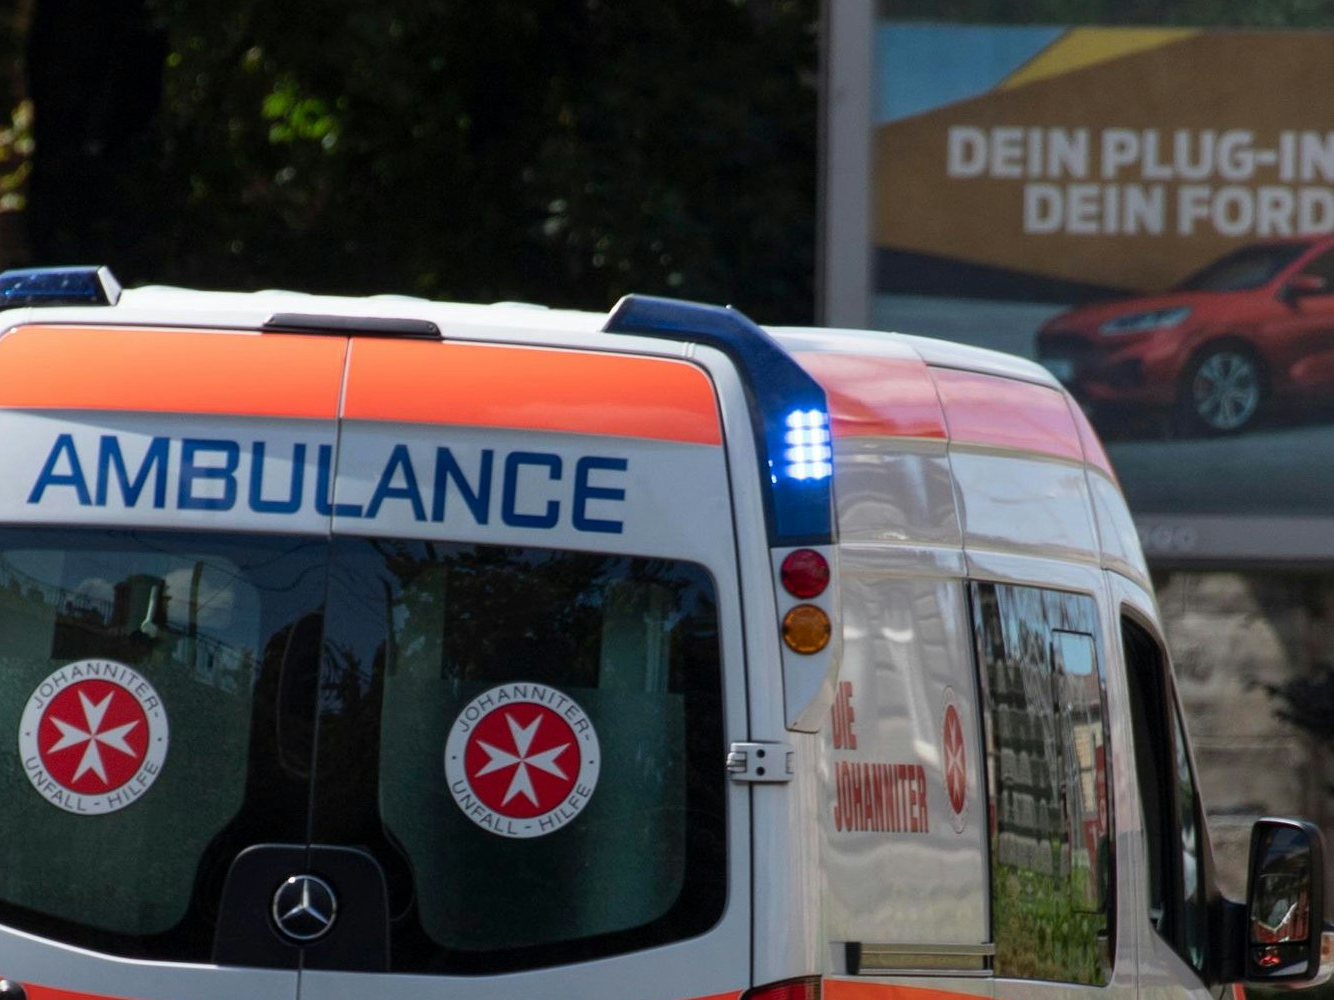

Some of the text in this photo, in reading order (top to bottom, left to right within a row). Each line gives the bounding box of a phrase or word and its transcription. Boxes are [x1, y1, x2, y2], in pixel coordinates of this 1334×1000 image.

[947, 126, 1090, 178] DEIN
[1023, 184, 1166, 233] DEIN
[27, 434, 628, 533] AMBULANCE
[33, 662, 159, 718] JOHANNITER-
[458, 685, 590, 741] JOHANNITER-
[831, 681, 857, 750] DIE
[834, 761, 929, 833] JOHANNITER
